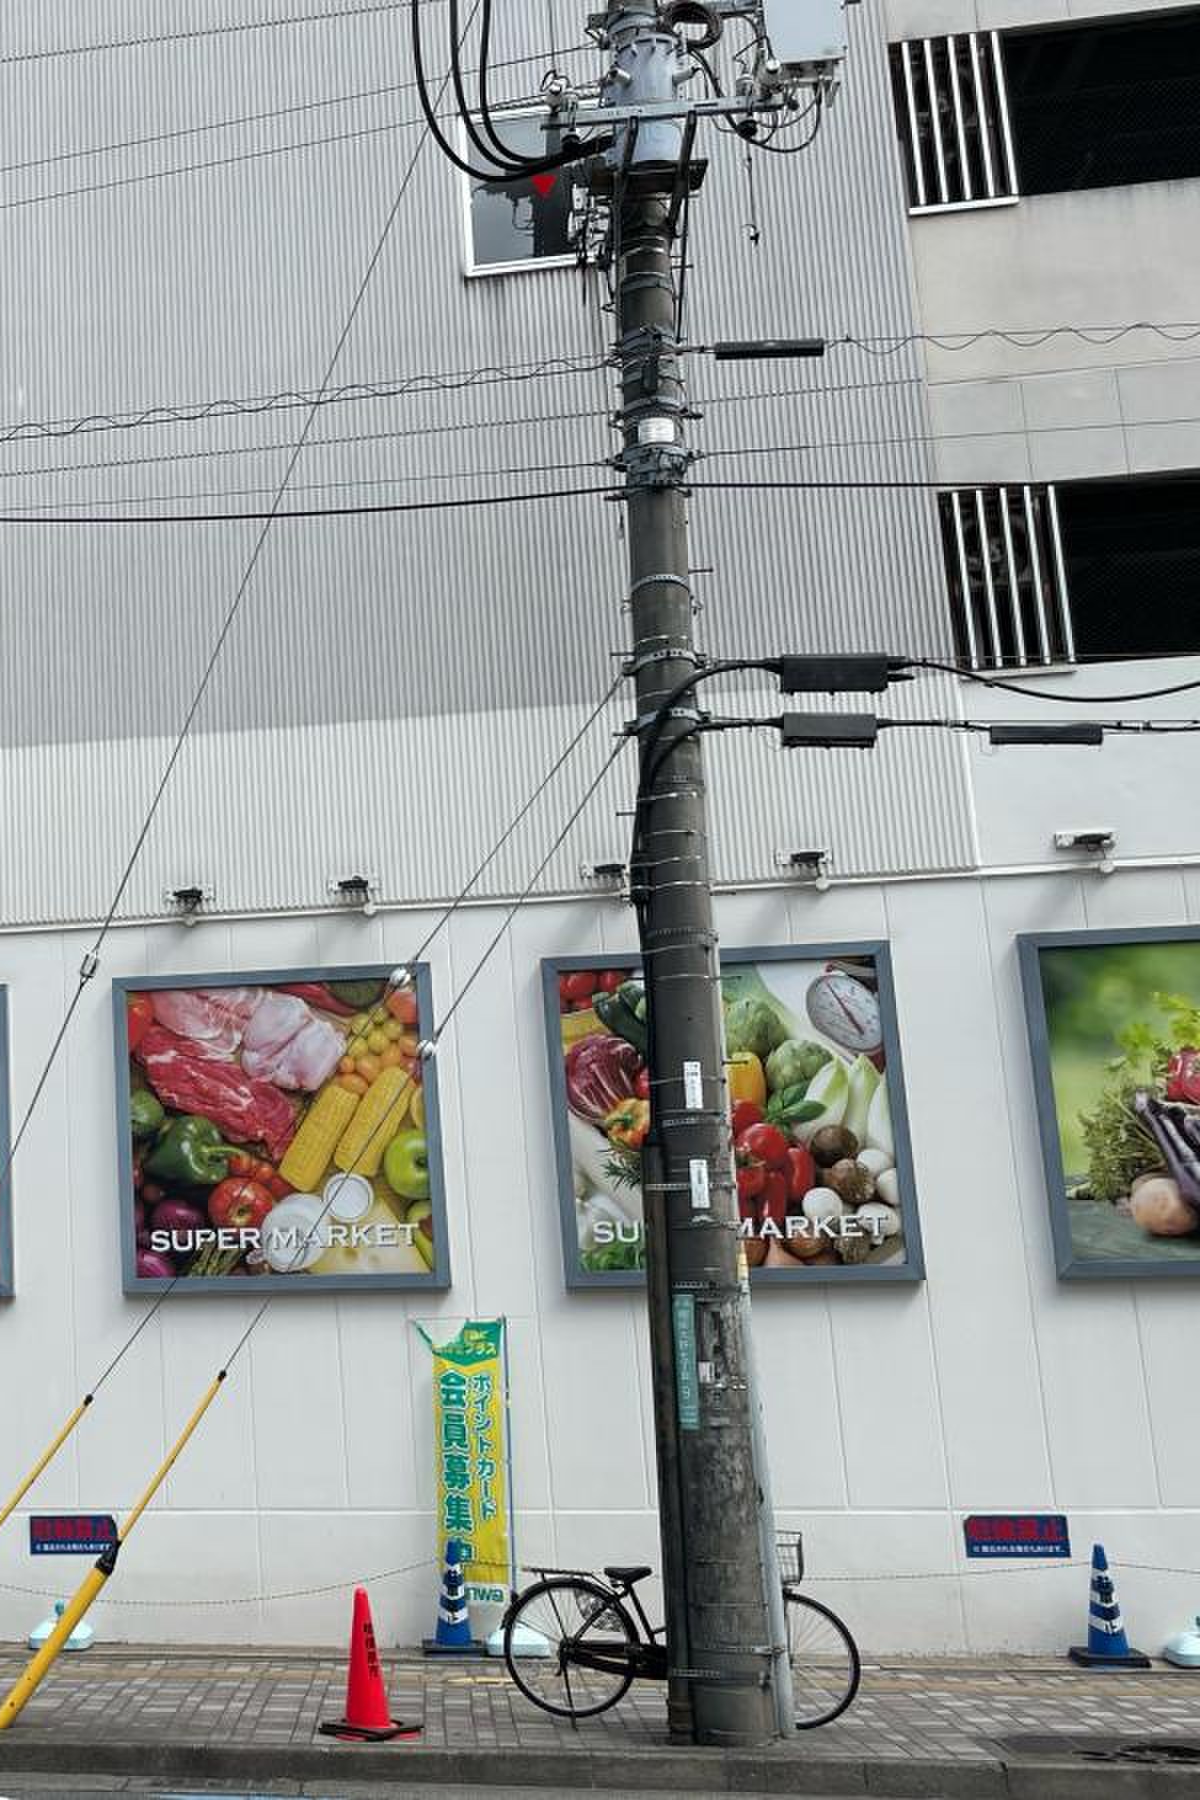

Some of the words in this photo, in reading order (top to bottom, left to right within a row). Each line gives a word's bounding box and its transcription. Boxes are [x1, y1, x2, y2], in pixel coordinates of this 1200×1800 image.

[150, 1226, 262, 1251] SUPER
[271, 1222, 420, 1249] MARKET
[464, 1586, 504, 1603] nwa
